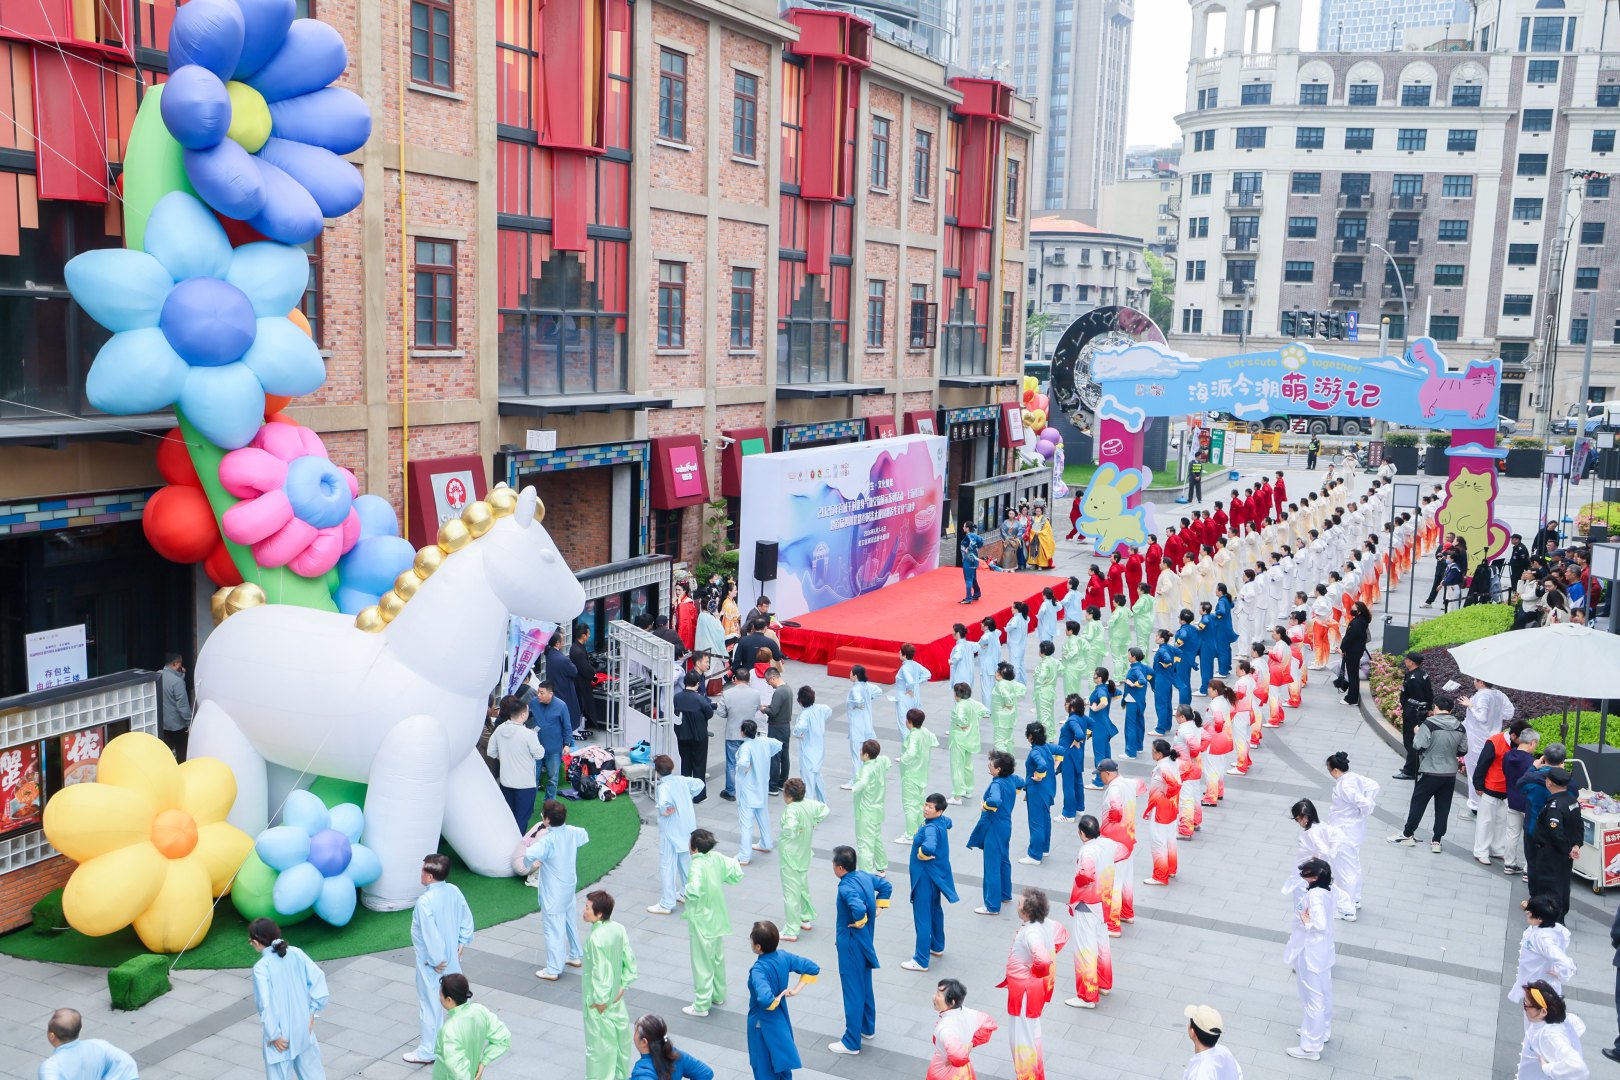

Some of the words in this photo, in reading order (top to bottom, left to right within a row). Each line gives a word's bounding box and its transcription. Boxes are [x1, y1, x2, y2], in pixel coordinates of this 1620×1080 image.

[1311, 359, 1363, 375] together!
[45, 665, 71, 679] 存包处
